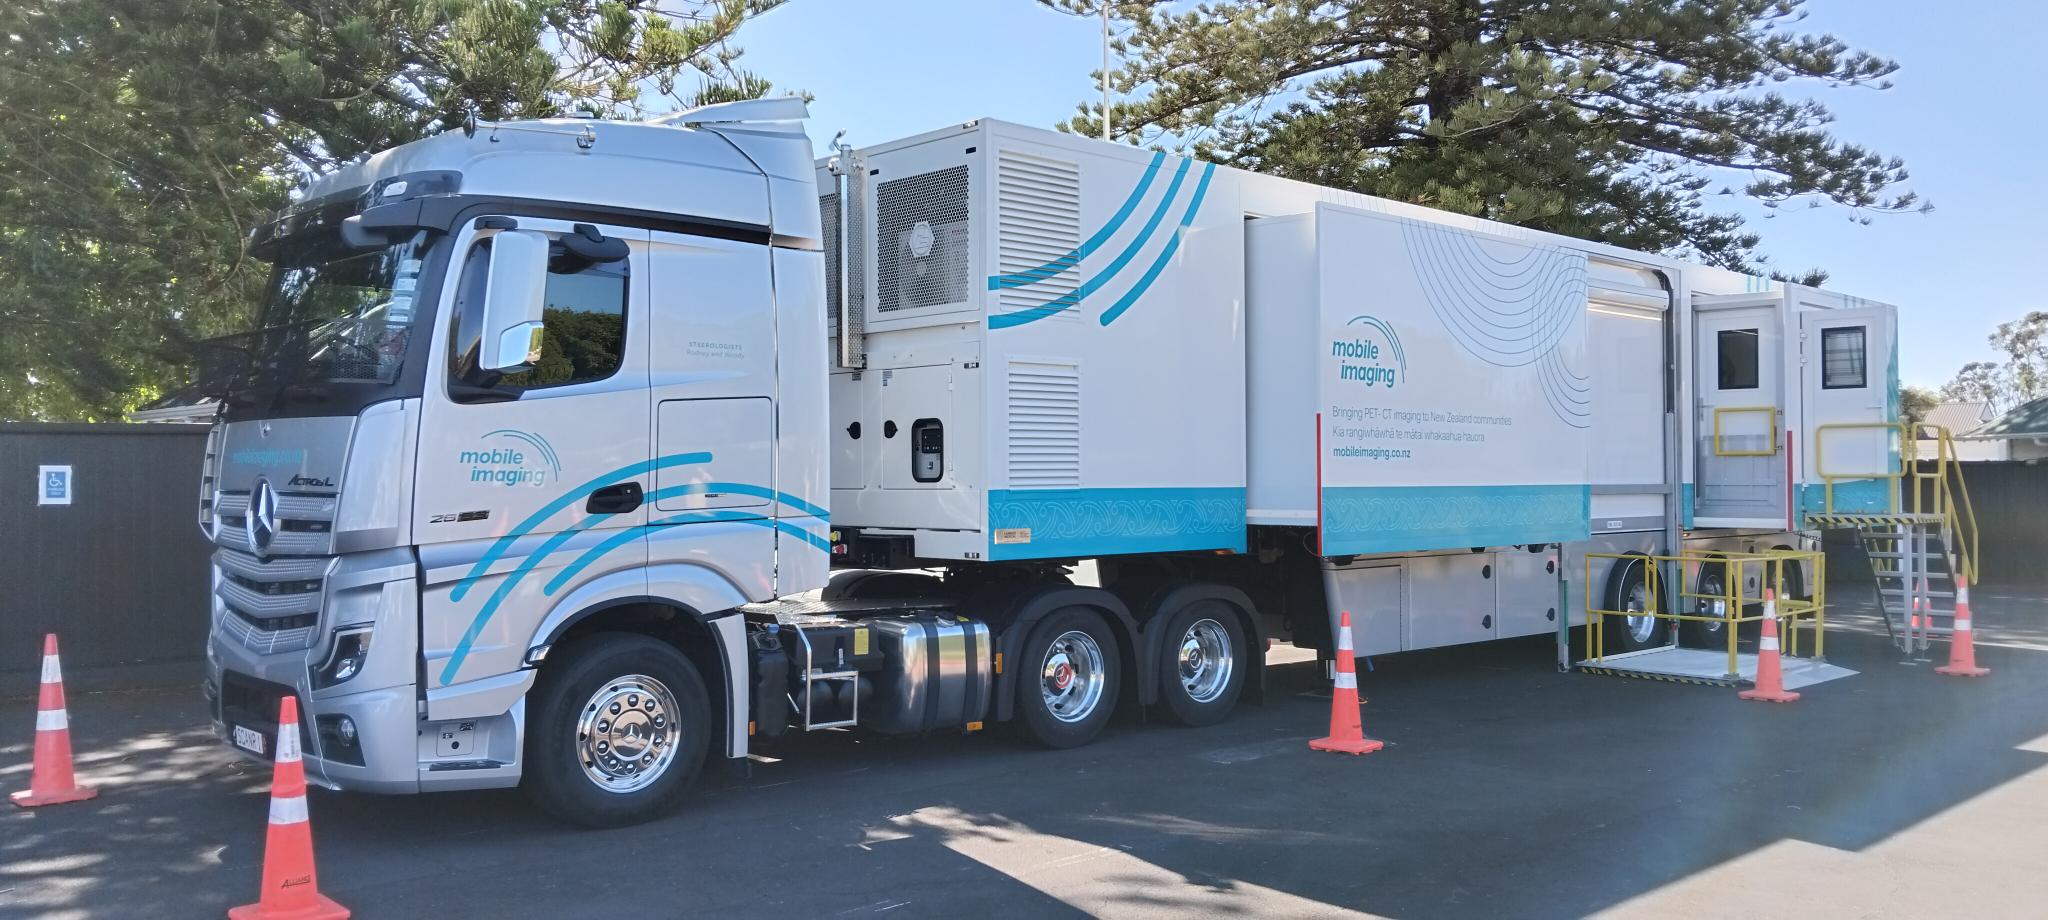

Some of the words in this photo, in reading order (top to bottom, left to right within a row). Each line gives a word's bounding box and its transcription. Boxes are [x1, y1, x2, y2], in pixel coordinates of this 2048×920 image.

[1332, 339, 1379, 359] mobile
[1341, 360, 1395, 388] imaging
[1332, 406, 1363, 421] Bringing
[1382, 408, 1393, 420] CT
[1393, 409, 1422, 424] imaging
[1423, 412, 1430, 422] to
[1430, 411, 1446, 423] New
[1446, 412, 1472, 424] Zealand
[1472, 414, 1512, 426] communities
[1332, 424, 1345, 438] Kia
[1395, 429, 1403, 440] te
[459, 448, 524, 464] mobile
[1333, 446, 1411, 460] mobileimaging.co.nz
[471, 466, 546, 487] imaging
